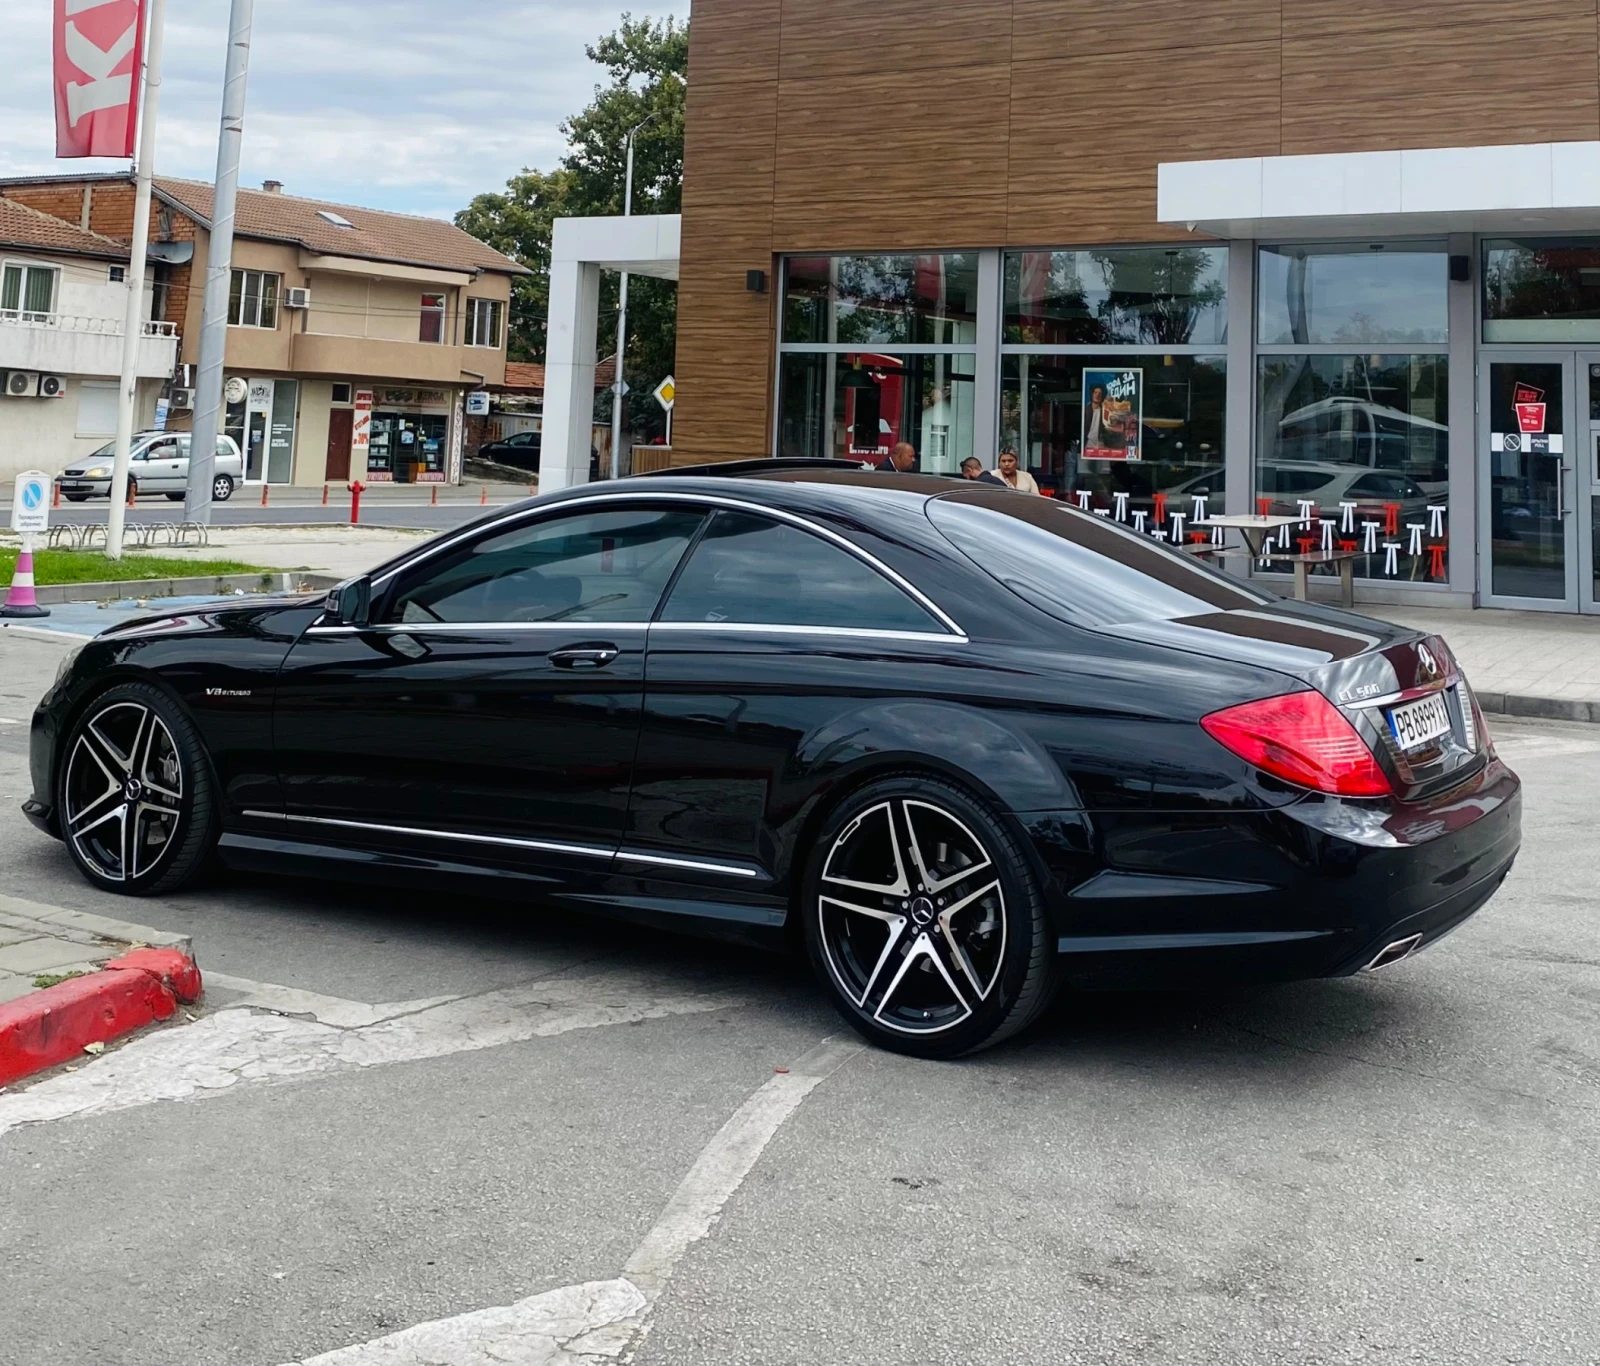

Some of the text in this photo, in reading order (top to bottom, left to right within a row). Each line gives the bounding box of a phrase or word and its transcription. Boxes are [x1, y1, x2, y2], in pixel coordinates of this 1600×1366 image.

[1122, 371, 1135, 383] ЗА
[1110, 380, 1136, 399] ЕДИН
[452, 403, 463, 483] АКУМУЛАТОРИ
[205, 687, 222, 696] V8
[1356, 683, 1381, 698] 500
